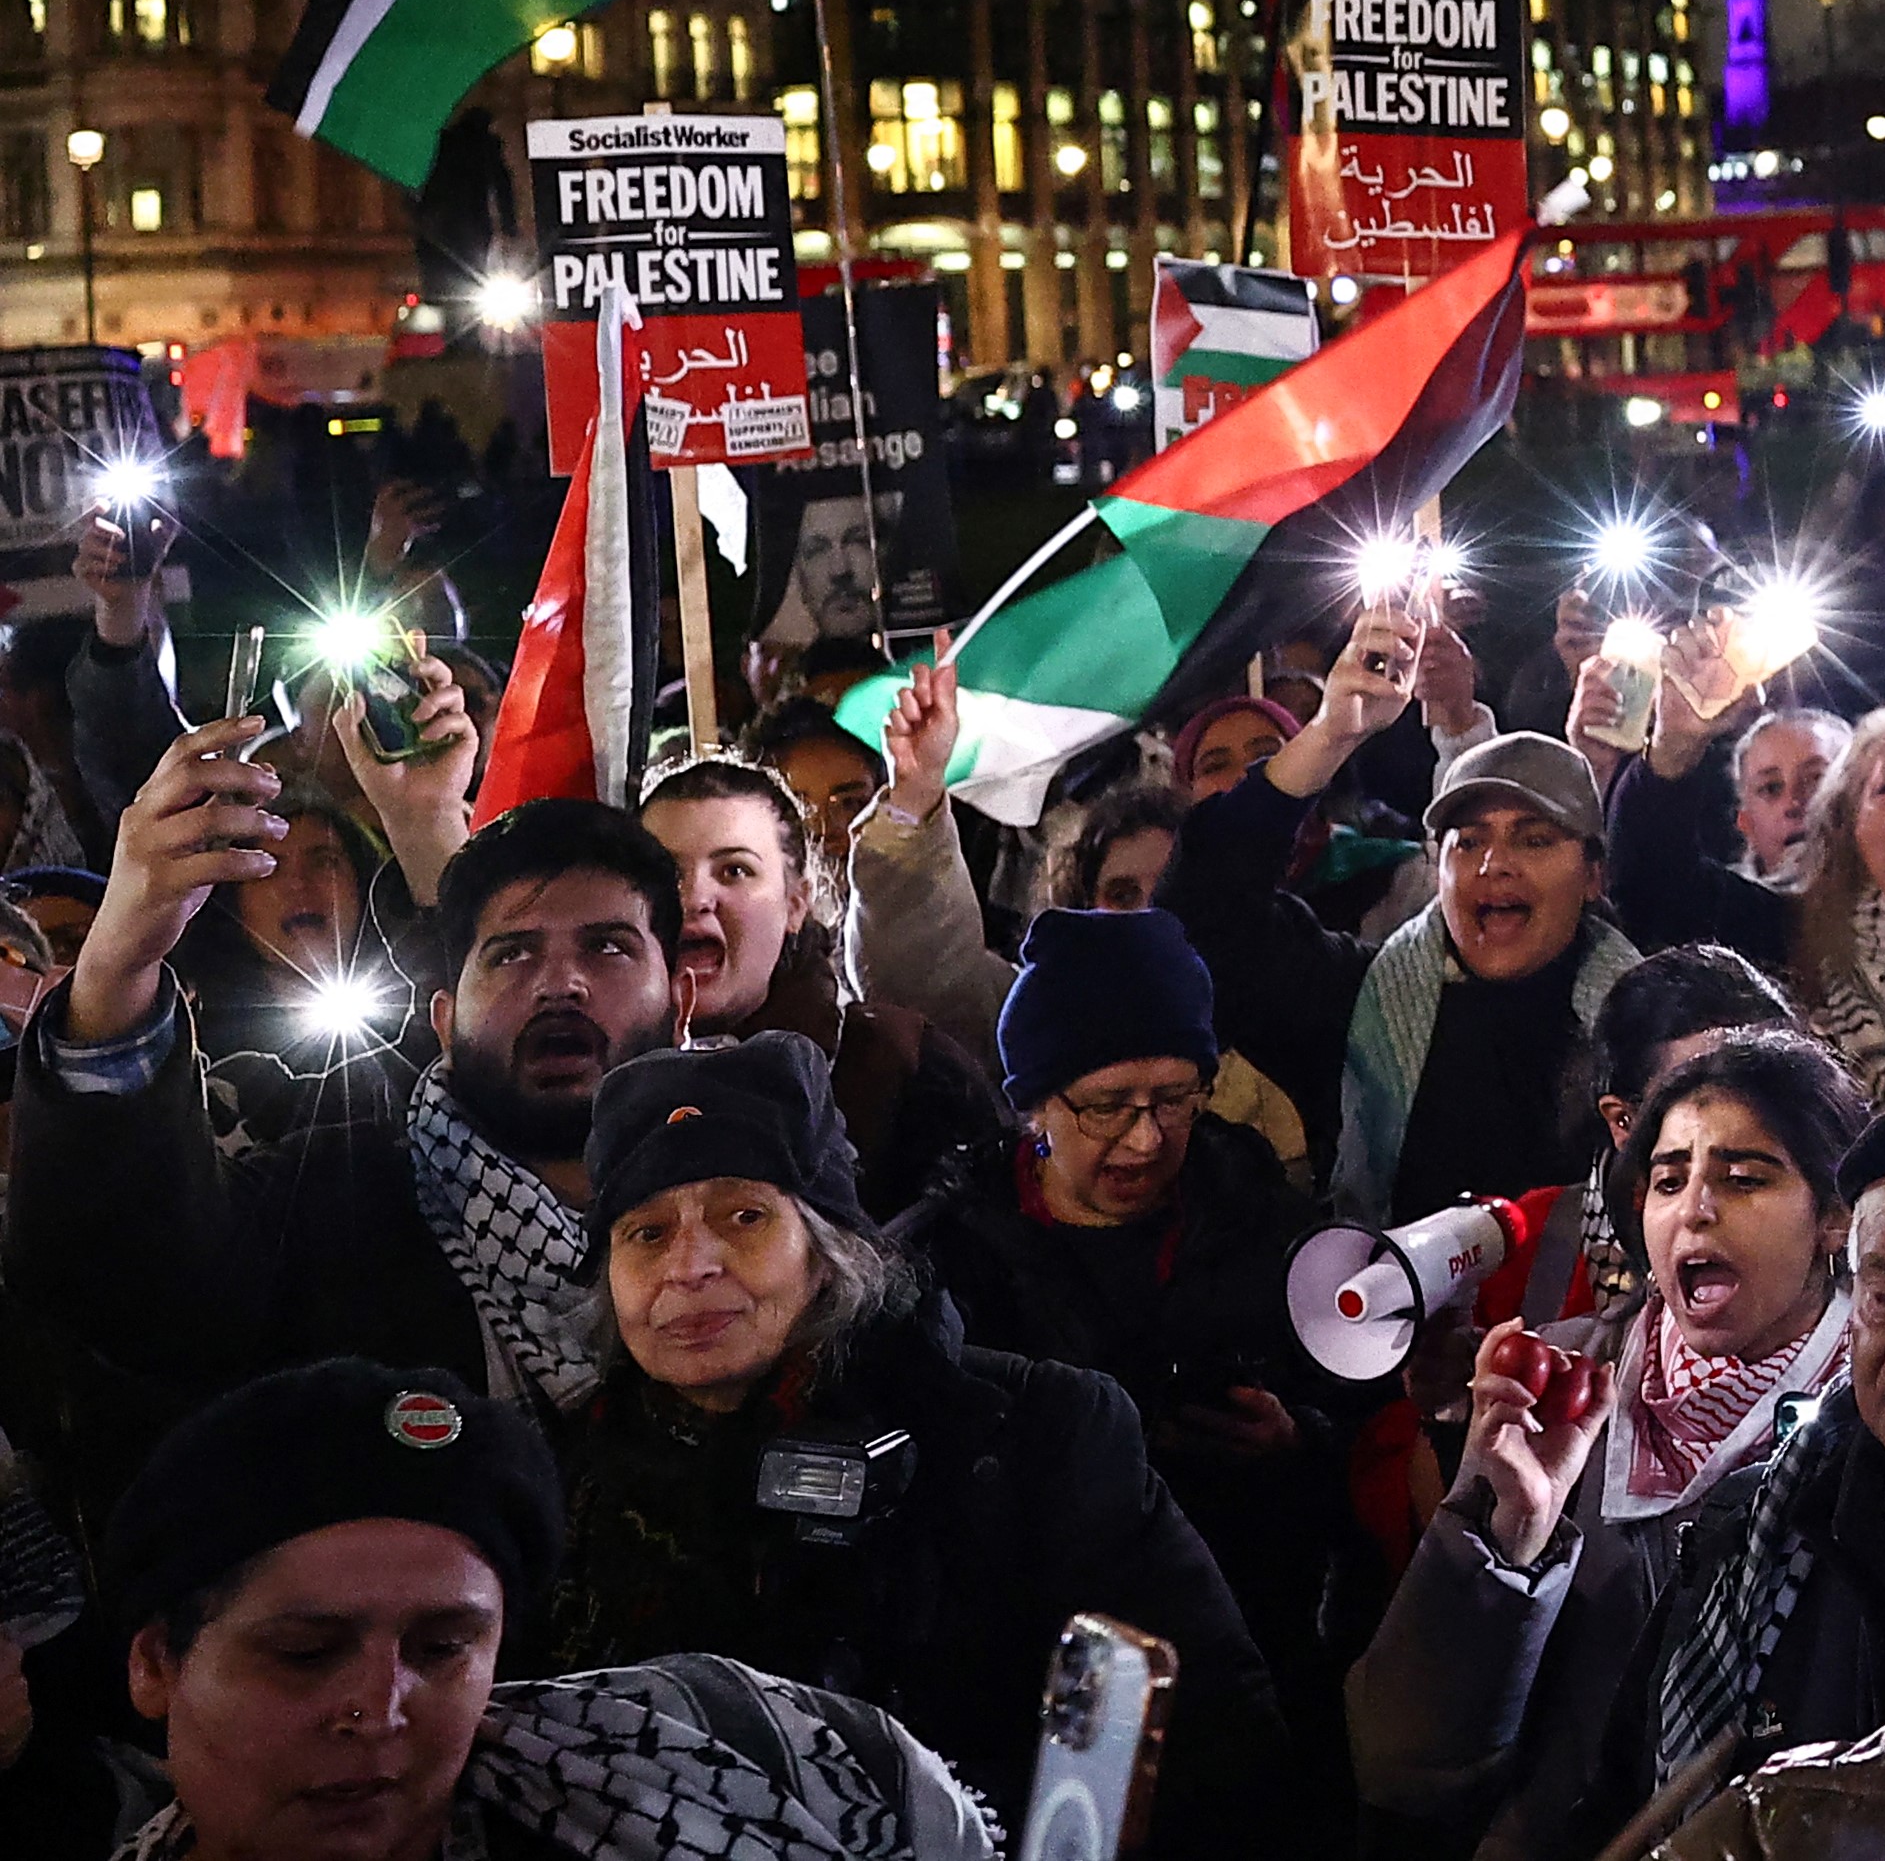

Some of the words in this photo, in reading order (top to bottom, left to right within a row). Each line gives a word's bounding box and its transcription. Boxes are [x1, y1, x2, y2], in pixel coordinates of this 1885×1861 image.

[1392, 44, 1424, 71] for
[1303, 69, 1510, 128] PALESTINE
[557, 164, 765, 225] FREEDOM
[1340, 144, 1474, 200] الحرية
[653, 219, 689, 247] for
[1323, 198, 1496, 250] لفلسطين
[552, 246, 784, 310] PALESTINE
